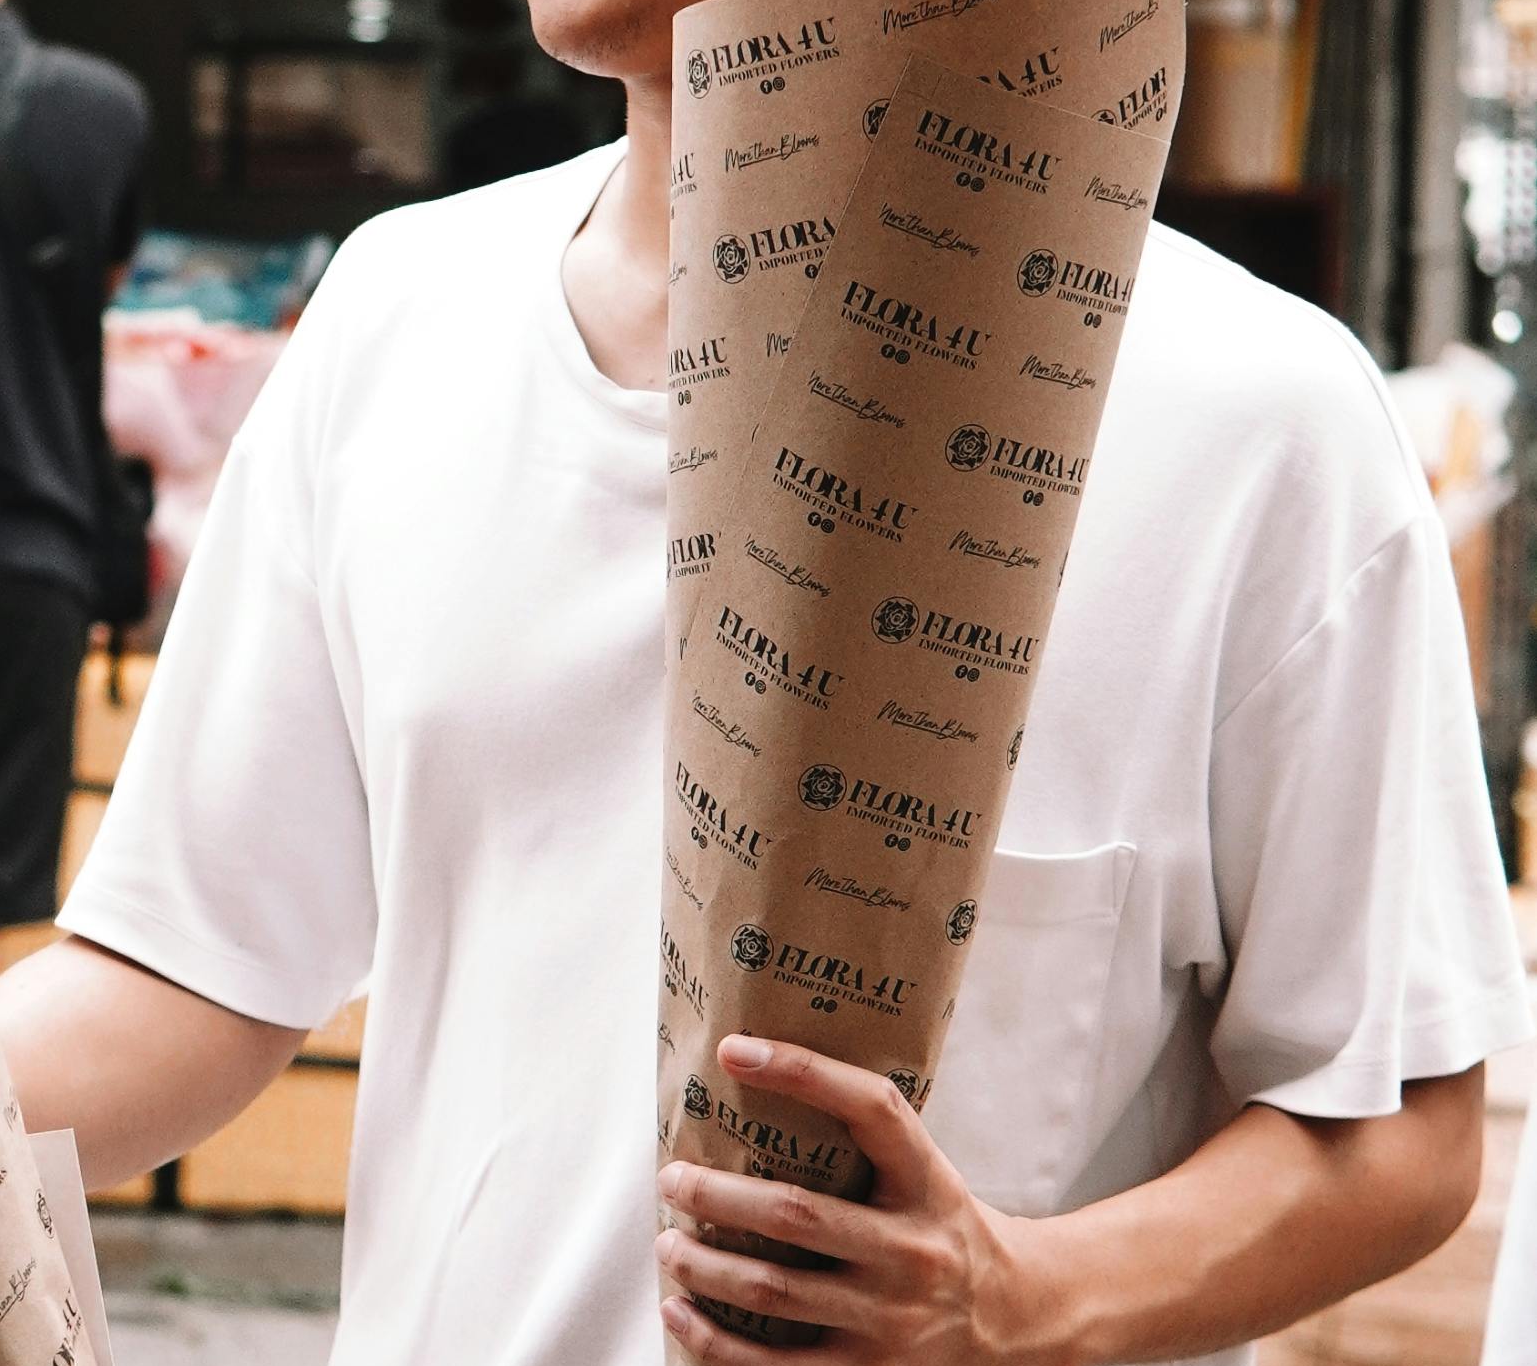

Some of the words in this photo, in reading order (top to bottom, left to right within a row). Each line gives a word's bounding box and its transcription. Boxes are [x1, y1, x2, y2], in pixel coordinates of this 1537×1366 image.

[712, 32, 791, 73] FLORA
[718, 63, 777, 86] IMPORTED
[780, 47, 840, 71] FLOWERS
[916, 109, 1012, 169] FLORA
[914, 137, 988, 173] IMPORTED
[989, 167, 1049, 195] FLOWERS
[749, 216, 836, 257] FLORA
[758, 247, 823, 271] IMPORTED
[1056, 288, 1104, 310] IMPORTED
[1059, 260, 1119, 299] FLORA
[843, 280, 938, 342] FLORA
[841, 307, 912, 348] IMPORTED
[913, 339, 979, 371] FLOWERS
[688, 366, 731, 385] FLOWERS
[774, 446, 863, 513] FLORA
[989, 465, 1045, 489] IMPORTED
[1047, 480, 1081, 497] FLOWERS
[992, 437, 1063, 479] FLORA
[773, 473, 837, 517] IMPORTED
[840, 510, 903, 543] FLOWERS
[717, 604, 789, 677] FLORA
[918, 638, 981, 664] IMPORTED
[984, 656, 1030, 675] FLOWERS
[921, 611, 1003, 656] FLORA
[716, 632, 769, 677] IMPORTED
[770, 672, 831, 712] FLOWERS
[676, 760, 727, 834] FLORA
[847, 779, 936, 827] FLORA
[710, 828, 759, 871] FLOWERS
[846, 805, 913, 834] IMPORTED
[915, 823, 971, 850] FLOWERS
[662, 925, 686, 983] ORA
[775, 943, 863, 989] FLORA
[773, 970, 839, 998] IMPORTED
[842, 989, 903, 1017] FLOWERS
[717, 1099, 798, 1160] FLORA
[717, 1120, 775, 1166] IMPORTED
[778, 1158, 836, 1183] FLOWERS
